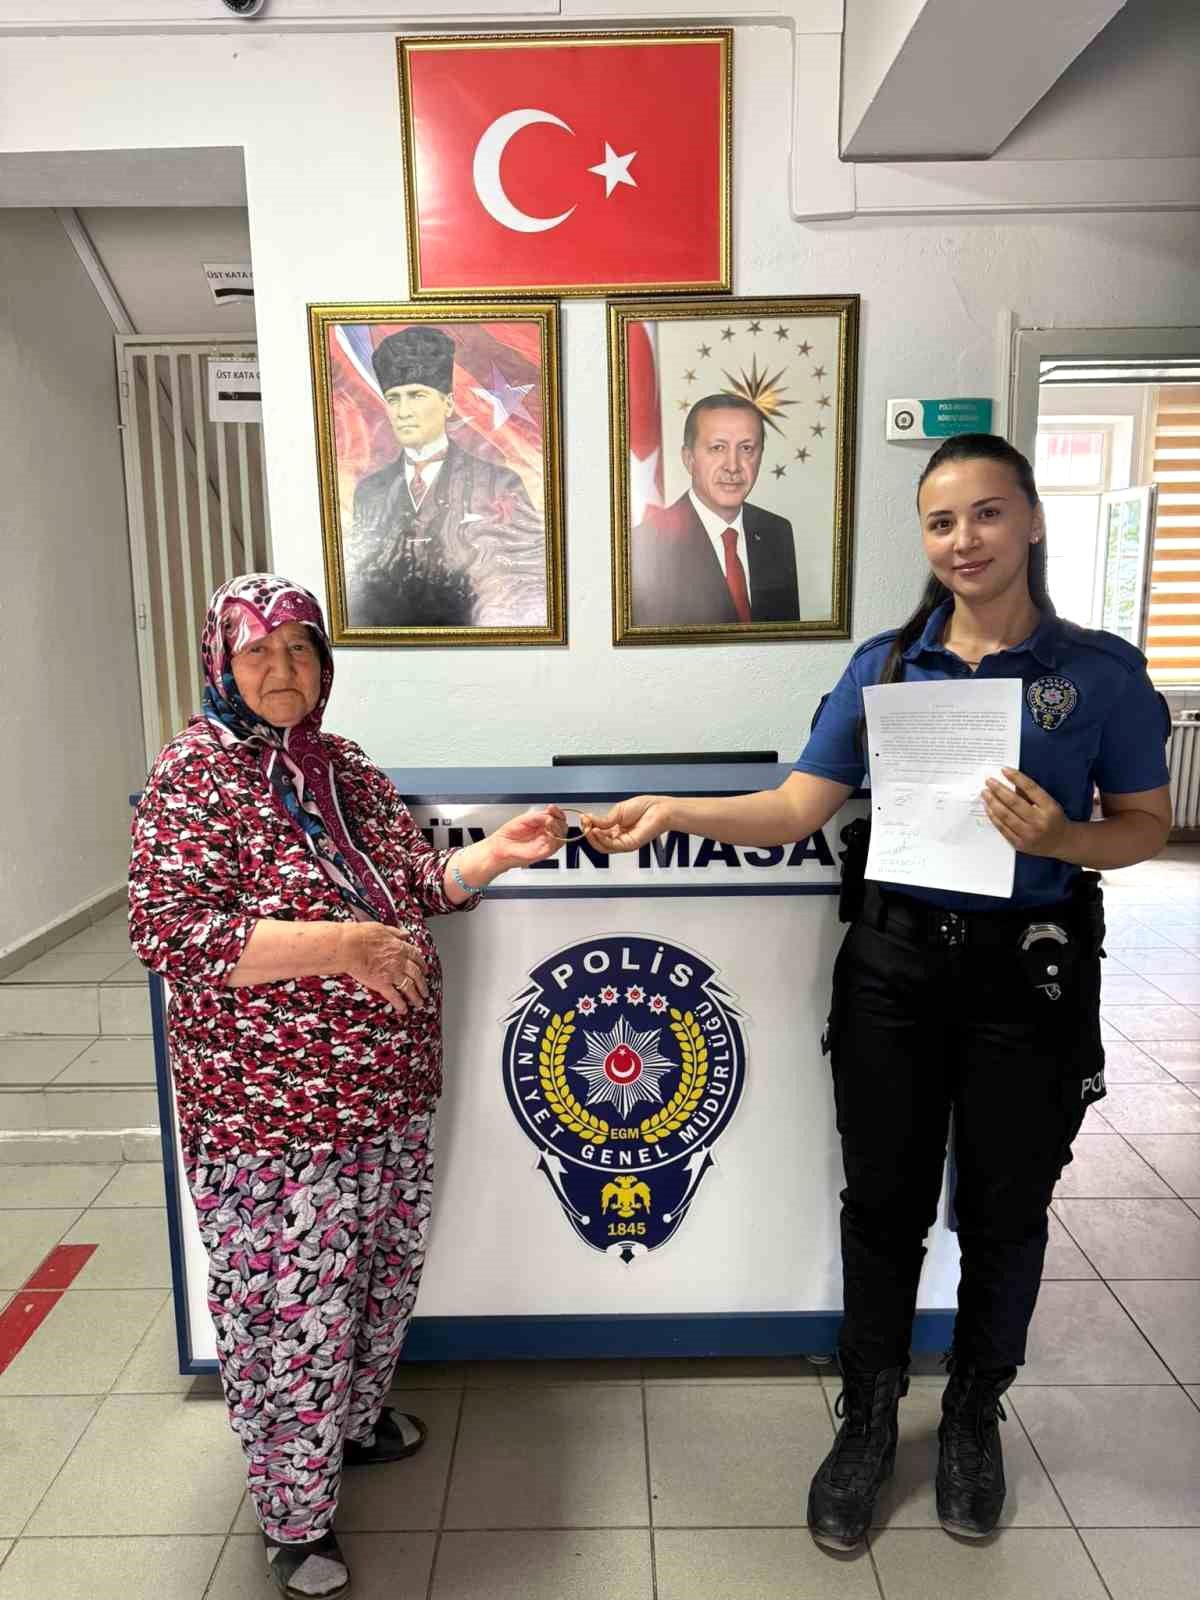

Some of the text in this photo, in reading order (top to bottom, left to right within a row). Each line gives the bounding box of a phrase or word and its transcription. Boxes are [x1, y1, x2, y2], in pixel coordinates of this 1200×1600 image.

[216, 369, 232, 379] ÜST
[233, 371, 255, 379] KATA
[551, 946, 694, 990] POLİS
[518, 1000, 730, 1165] EMNİYET GENEL MÜDÜRLÜĞÜ
[610, 1127, 640, 1141] EGM
[607, 1222, 646, 1237] 1845
